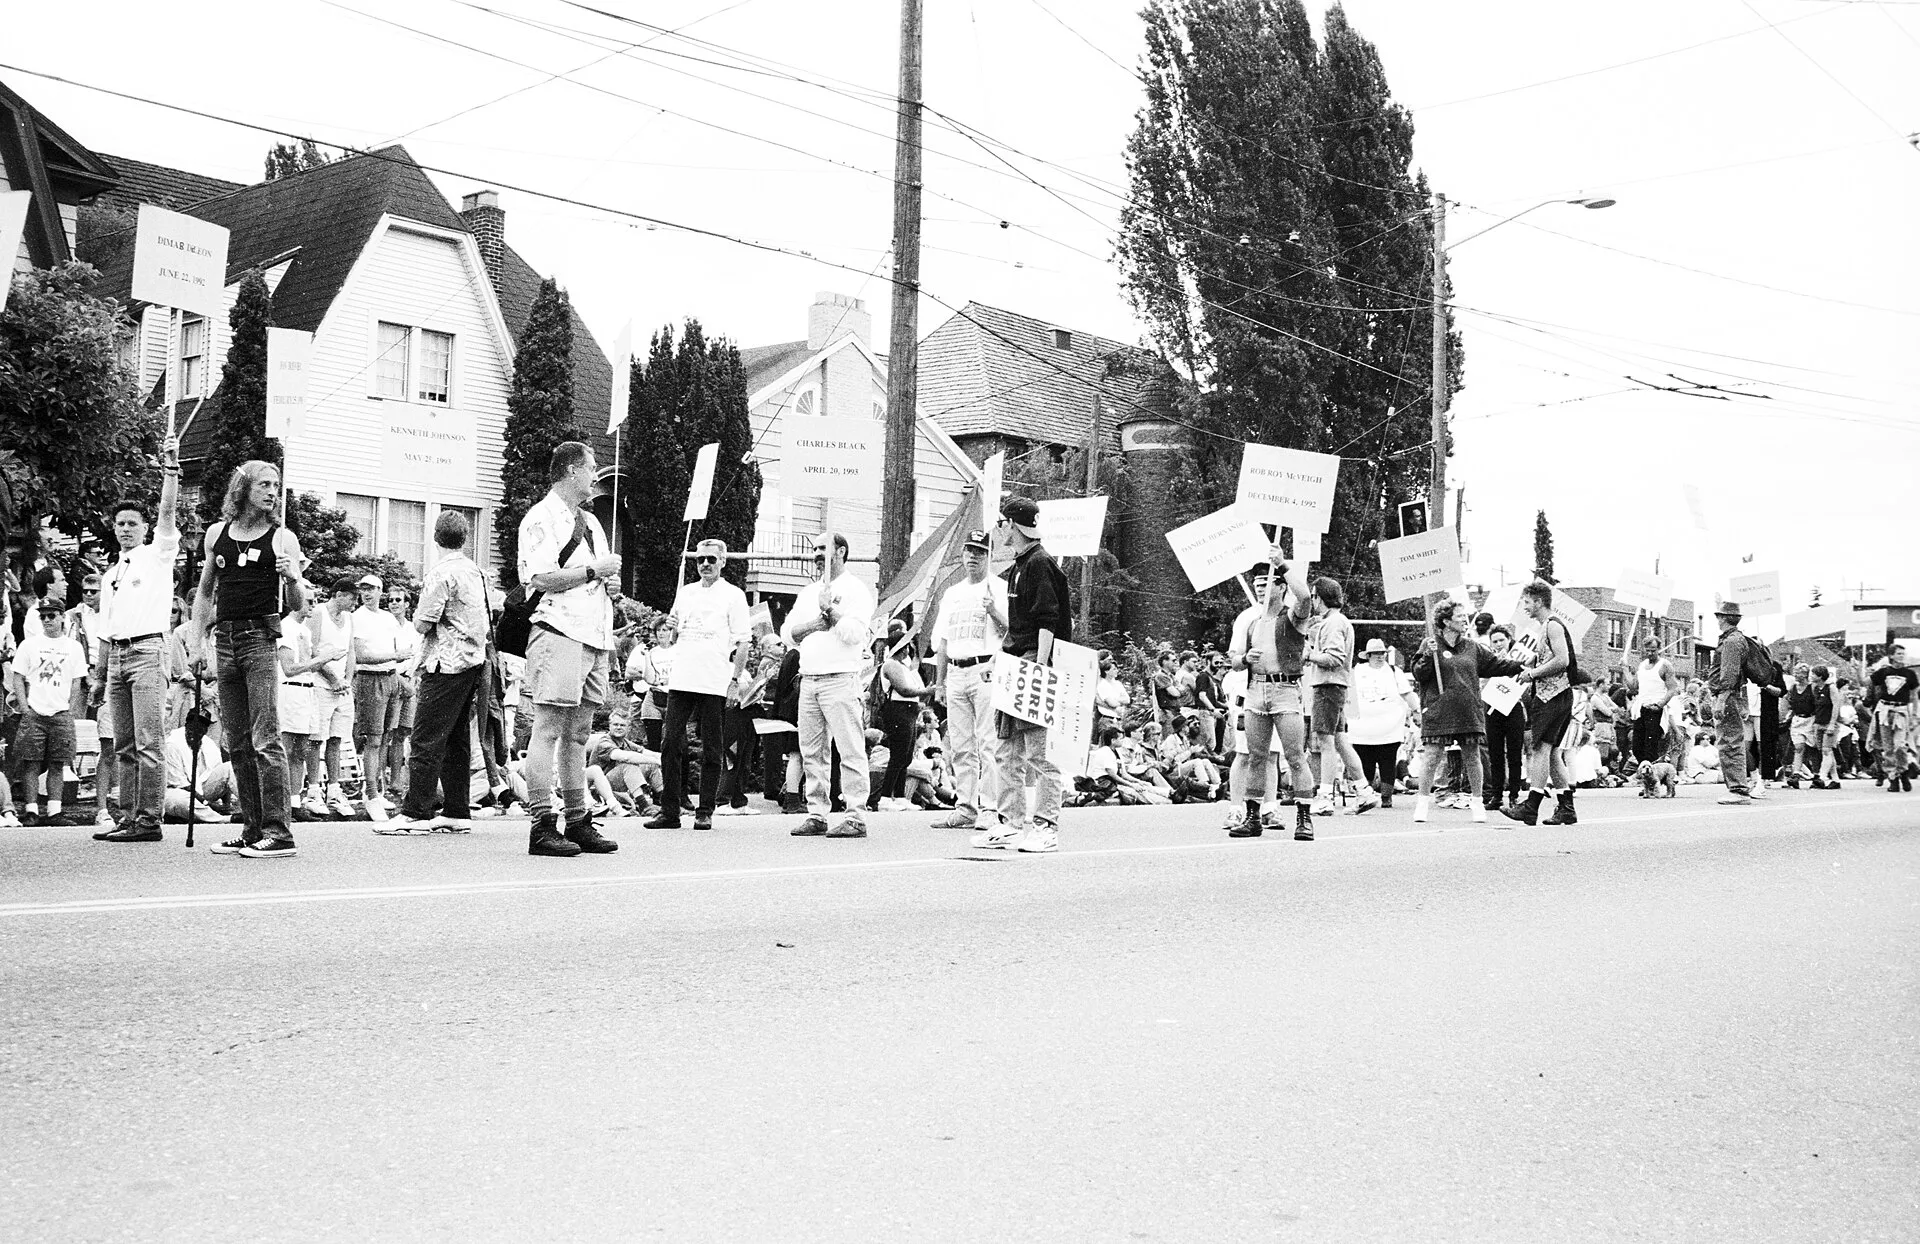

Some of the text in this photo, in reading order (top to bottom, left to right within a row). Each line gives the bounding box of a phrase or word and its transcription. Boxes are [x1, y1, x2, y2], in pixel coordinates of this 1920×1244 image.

[158, 267, 180, 280] JUNE
[390, 425, 466, 442] KENNETH JOHNSON
[796, 439, 866, 450] CHARLES BLACK
[404, 452, 422, 461] MAY
[802, 466, 827, 474] APRIL
[829, 467, 840, 476] 20,
[1250, 467, 1266, 475] ROB
[1267, 469, 1284, 478] ROY
[1247, 491, 1290, 505] DECEMBER
[1300, 499, 1317, 509] 1992
[1181, 536, 1206, 553] DANIEL
[1206, 553, 1224, 566] JULY
[1231, 543, 1246, 554] 1992
[1399, 548, 1440, 563] TOM WHITE
[1401, 573, 1417, 583] MAY
[1013, 660, 1028, 714] NOW
[1027, 665, 1043, 720] CURE
[1043, 670, 1058, 726] AIDS
